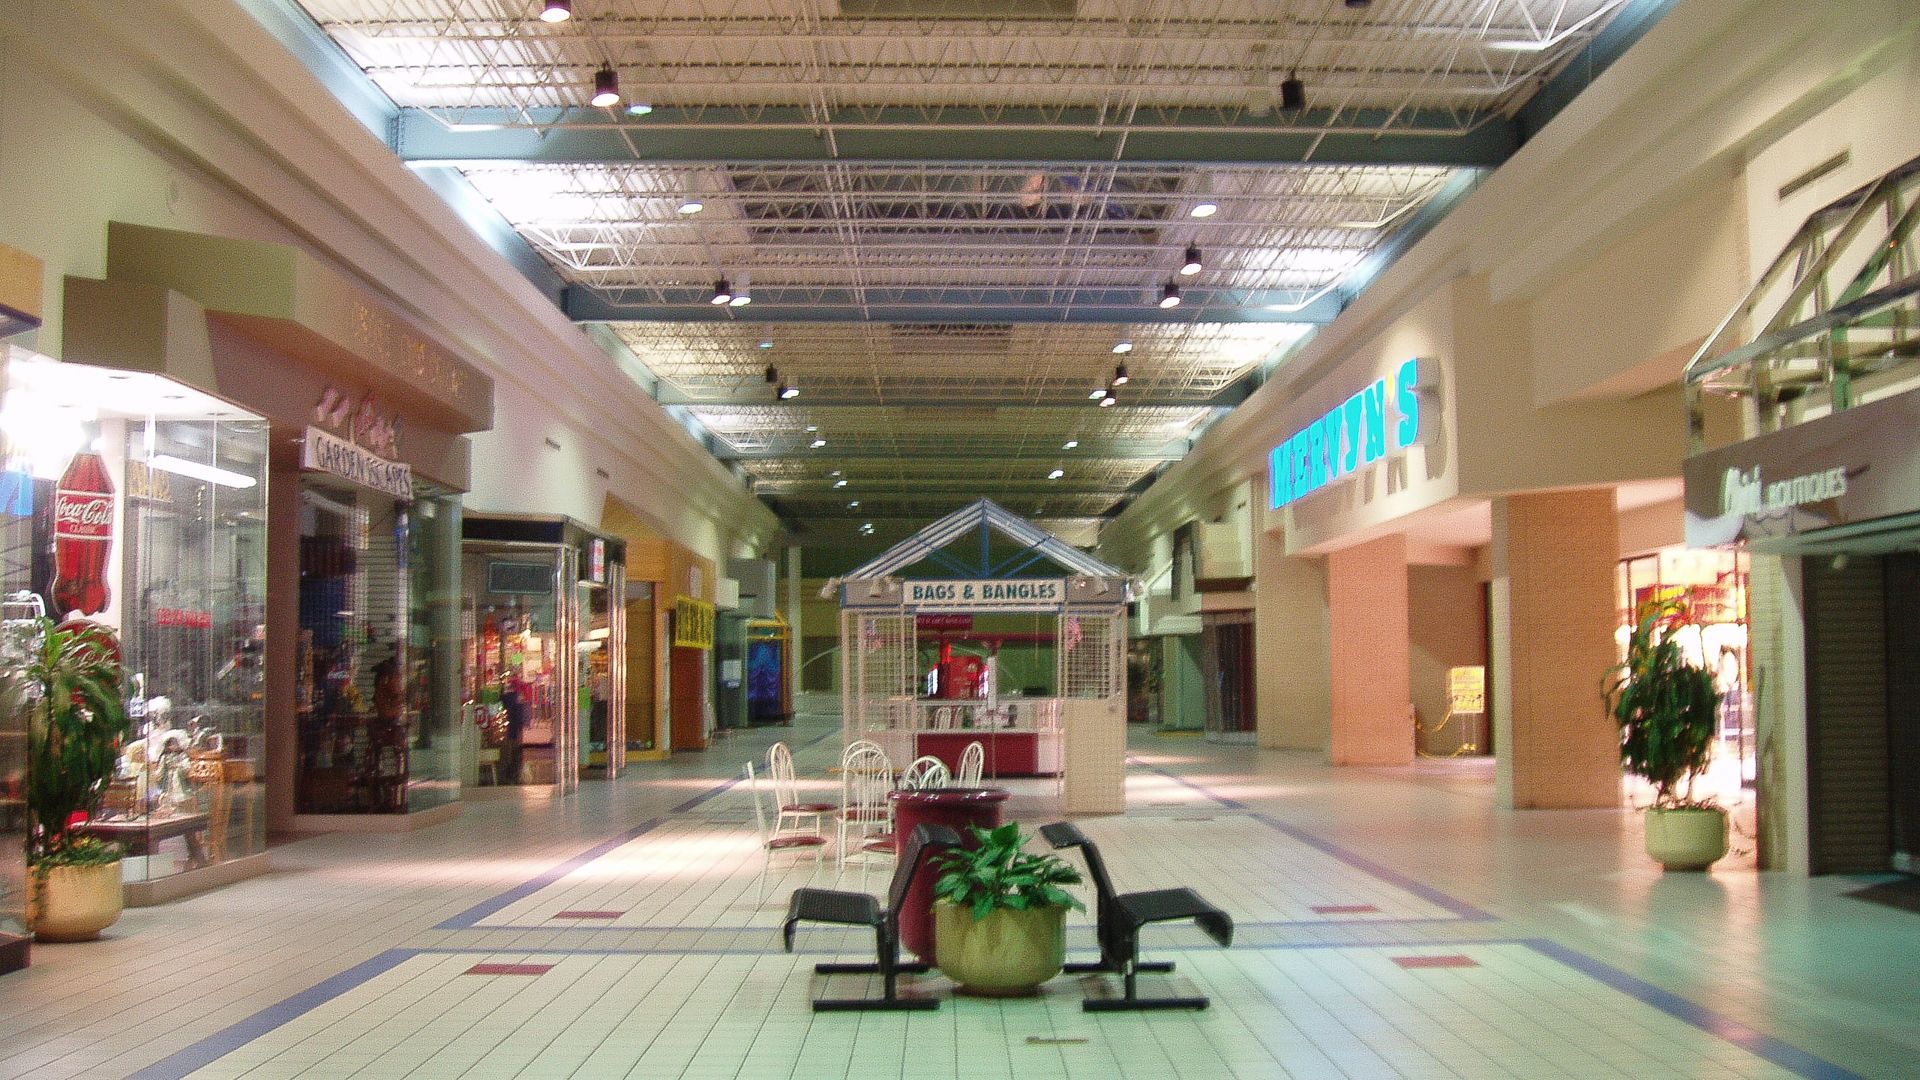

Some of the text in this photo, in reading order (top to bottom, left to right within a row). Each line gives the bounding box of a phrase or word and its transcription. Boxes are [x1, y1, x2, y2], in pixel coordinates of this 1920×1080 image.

[1271, 358, 1419, 510] MERVYN'S
[913, 583, 1056, 600] BAGS & BANGLES
